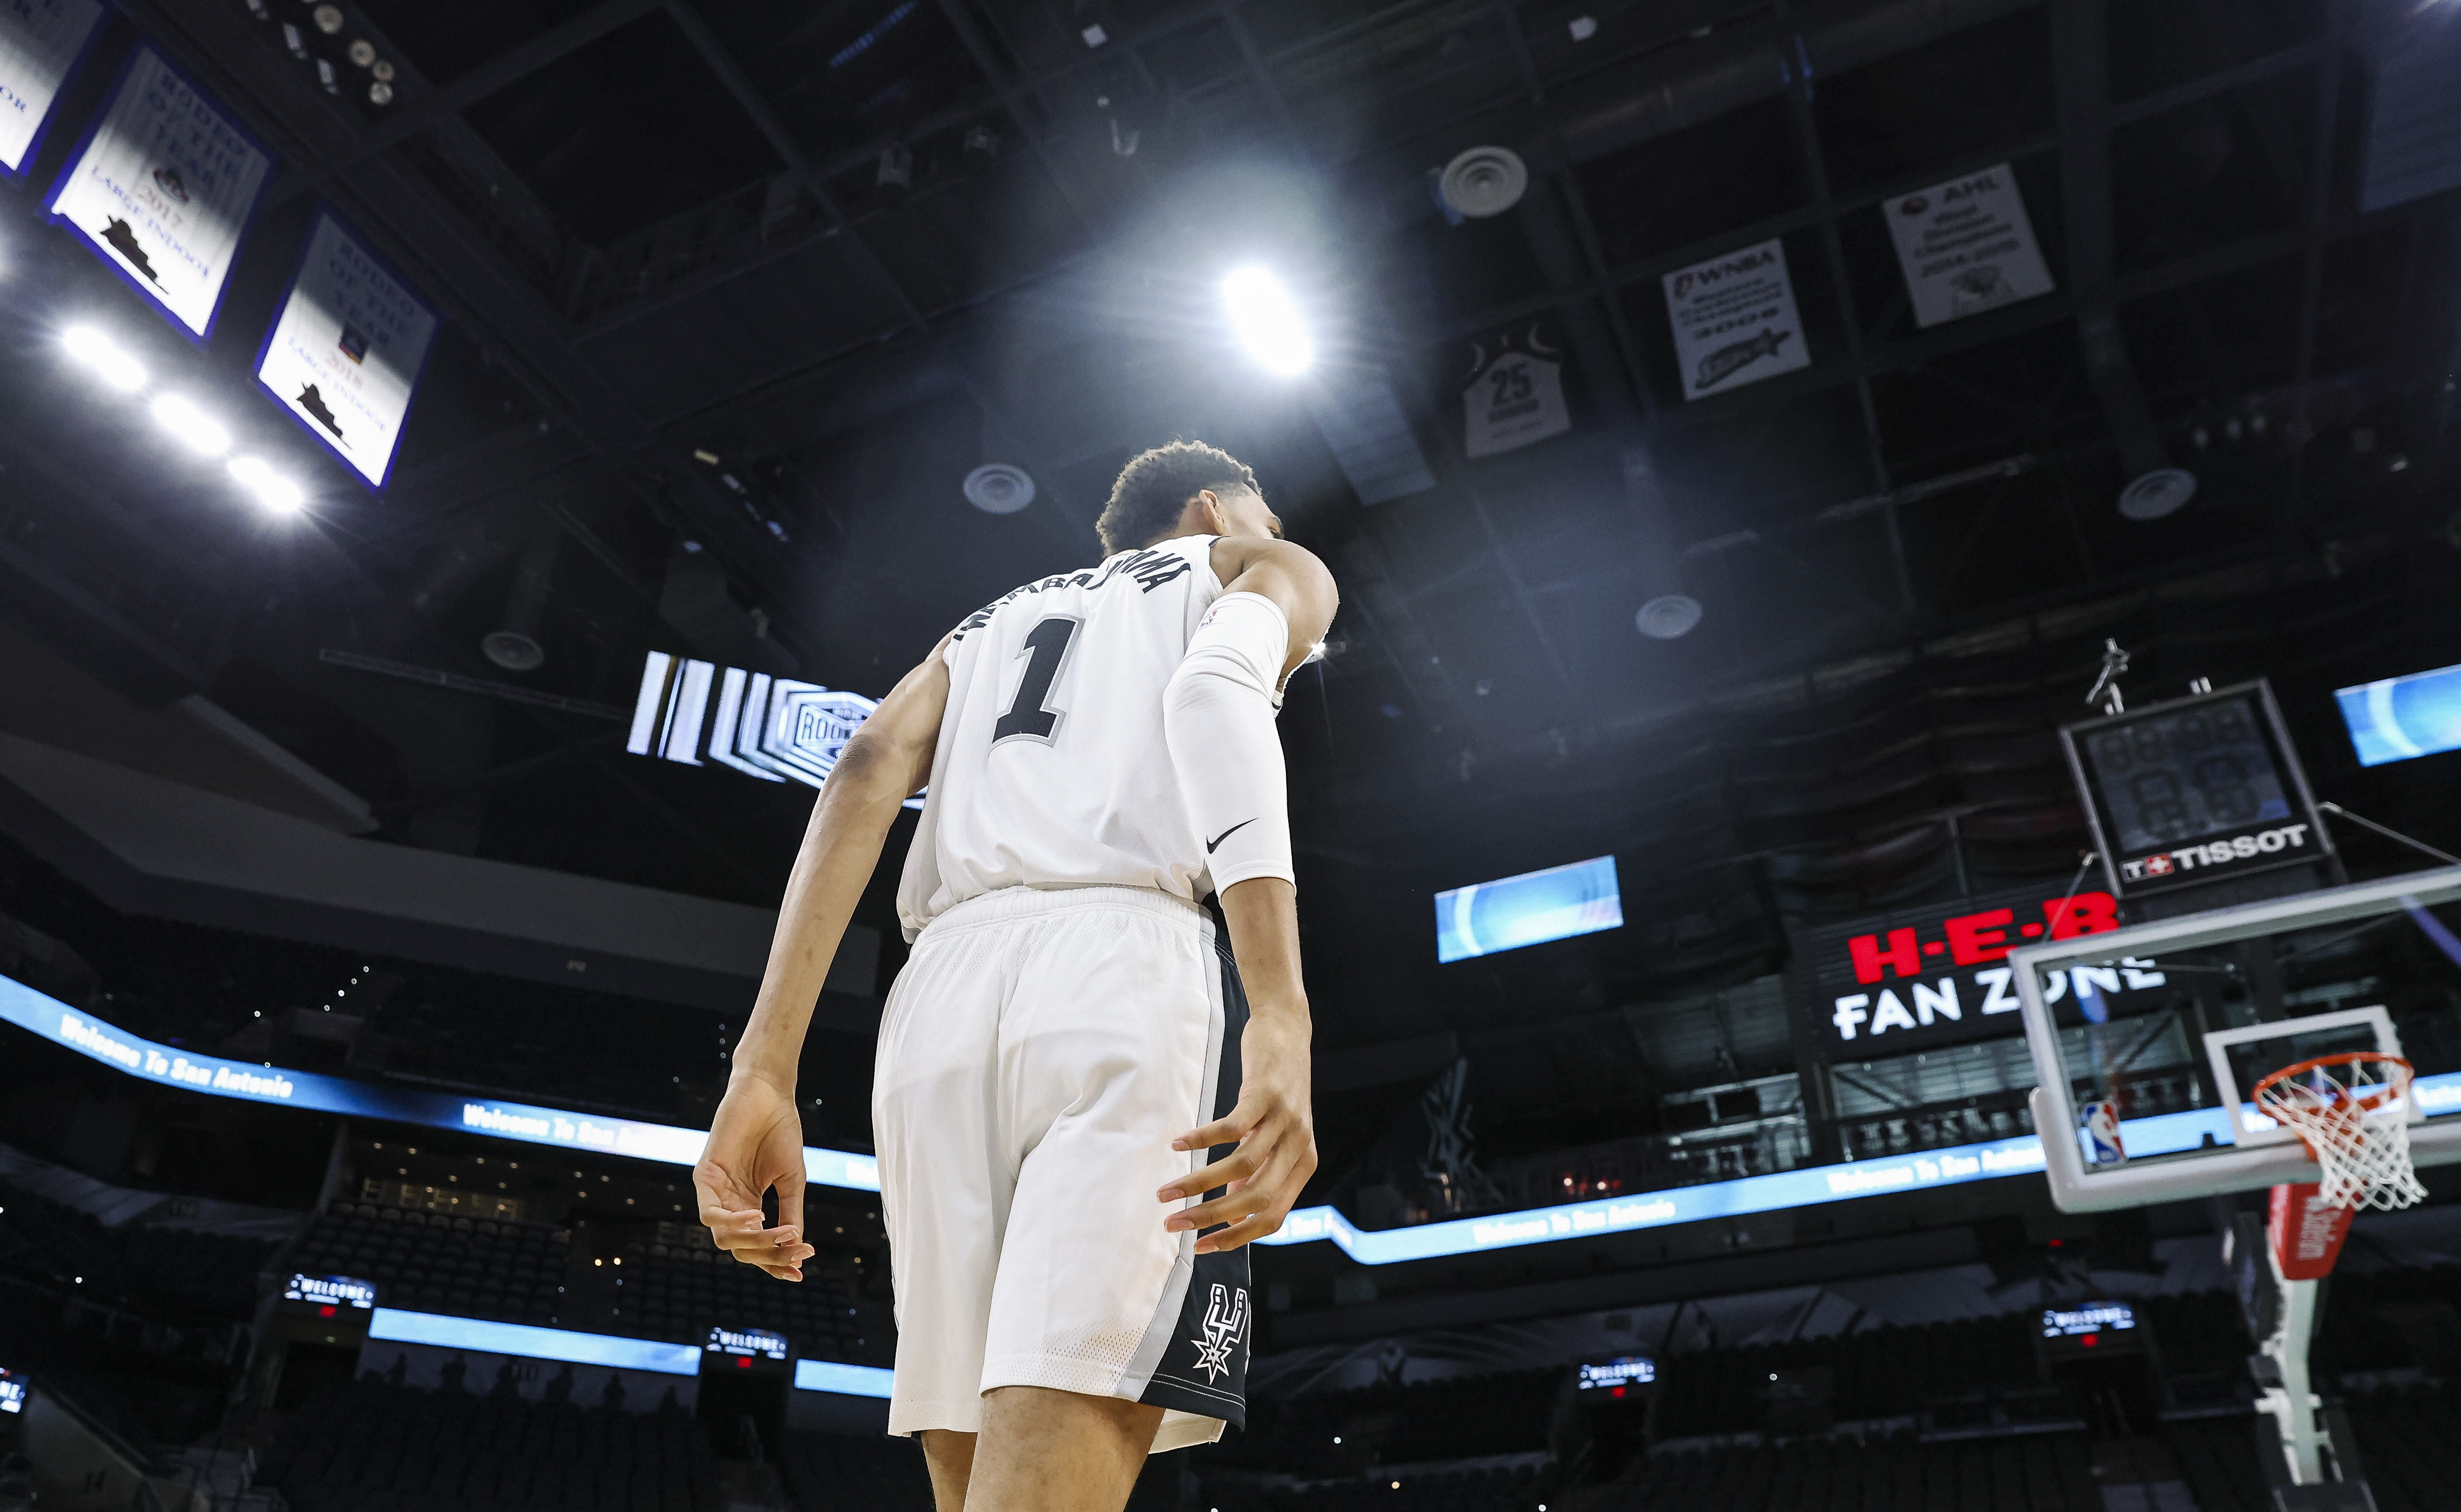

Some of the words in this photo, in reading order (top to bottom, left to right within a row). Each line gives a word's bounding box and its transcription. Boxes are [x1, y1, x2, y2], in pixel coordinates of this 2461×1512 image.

[88, 164, 145, 220] LARGE
[137, 183, 183, 231] 2017
[1697, 249, 1774, 286] WNBA
[1489, 360, 1531, 407] 25
[990, 614, 1085, 750] 1
[2171, 824, 2308, 870] TISSOT
[1832, 977, 1962, 1040] FAN
[60, 1014, 142, 1068] Welcome
[145, 1049, 169, 1076] To
[170, 1057, 212, 1085] San
[212, 1067, 294, 1098] Antonio
[463, 1103, 550, 1136] Welcome
[554, 1117, 575, 1140] To
[577, 1120, 615, 1146] San
